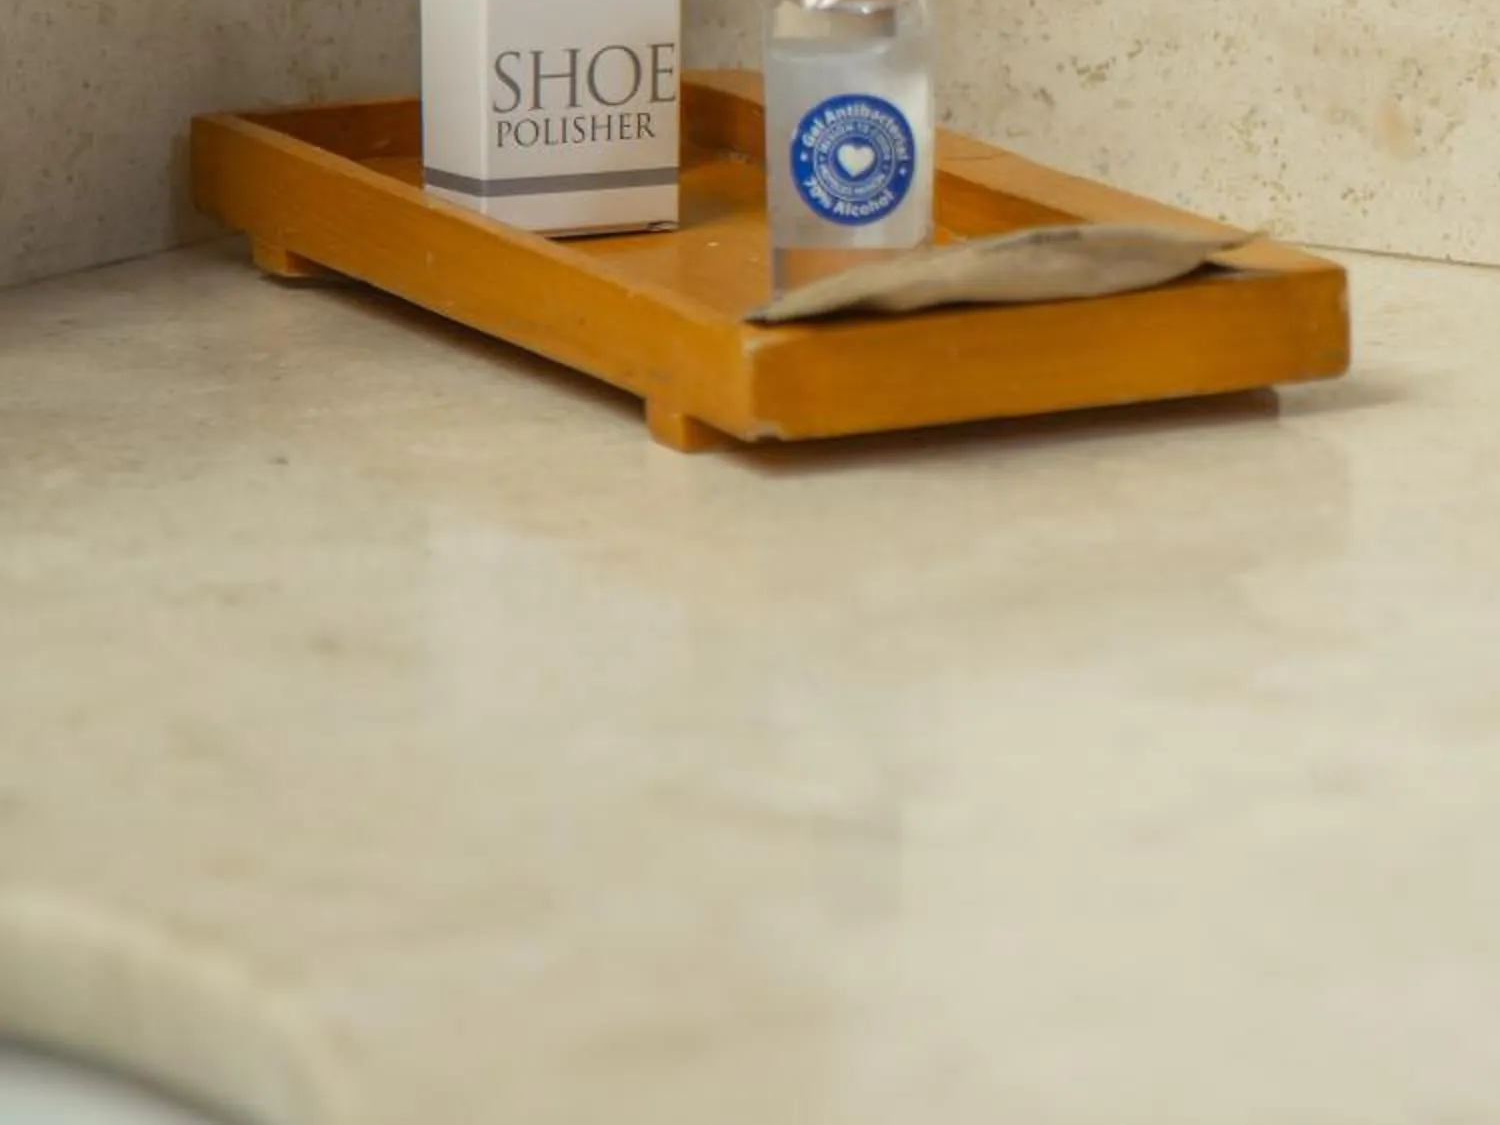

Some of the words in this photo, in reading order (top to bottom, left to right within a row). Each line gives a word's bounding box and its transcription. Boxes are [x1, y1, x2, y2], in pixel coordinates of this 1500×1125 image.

[493, 43, 675, 113] SHOE
[497, 112, 655, 147] POLISHER
[801, 116, 826, 148] Gel
[803, 178, 832, 210] 70%
[832, 189, 895, 218] Alcohol
